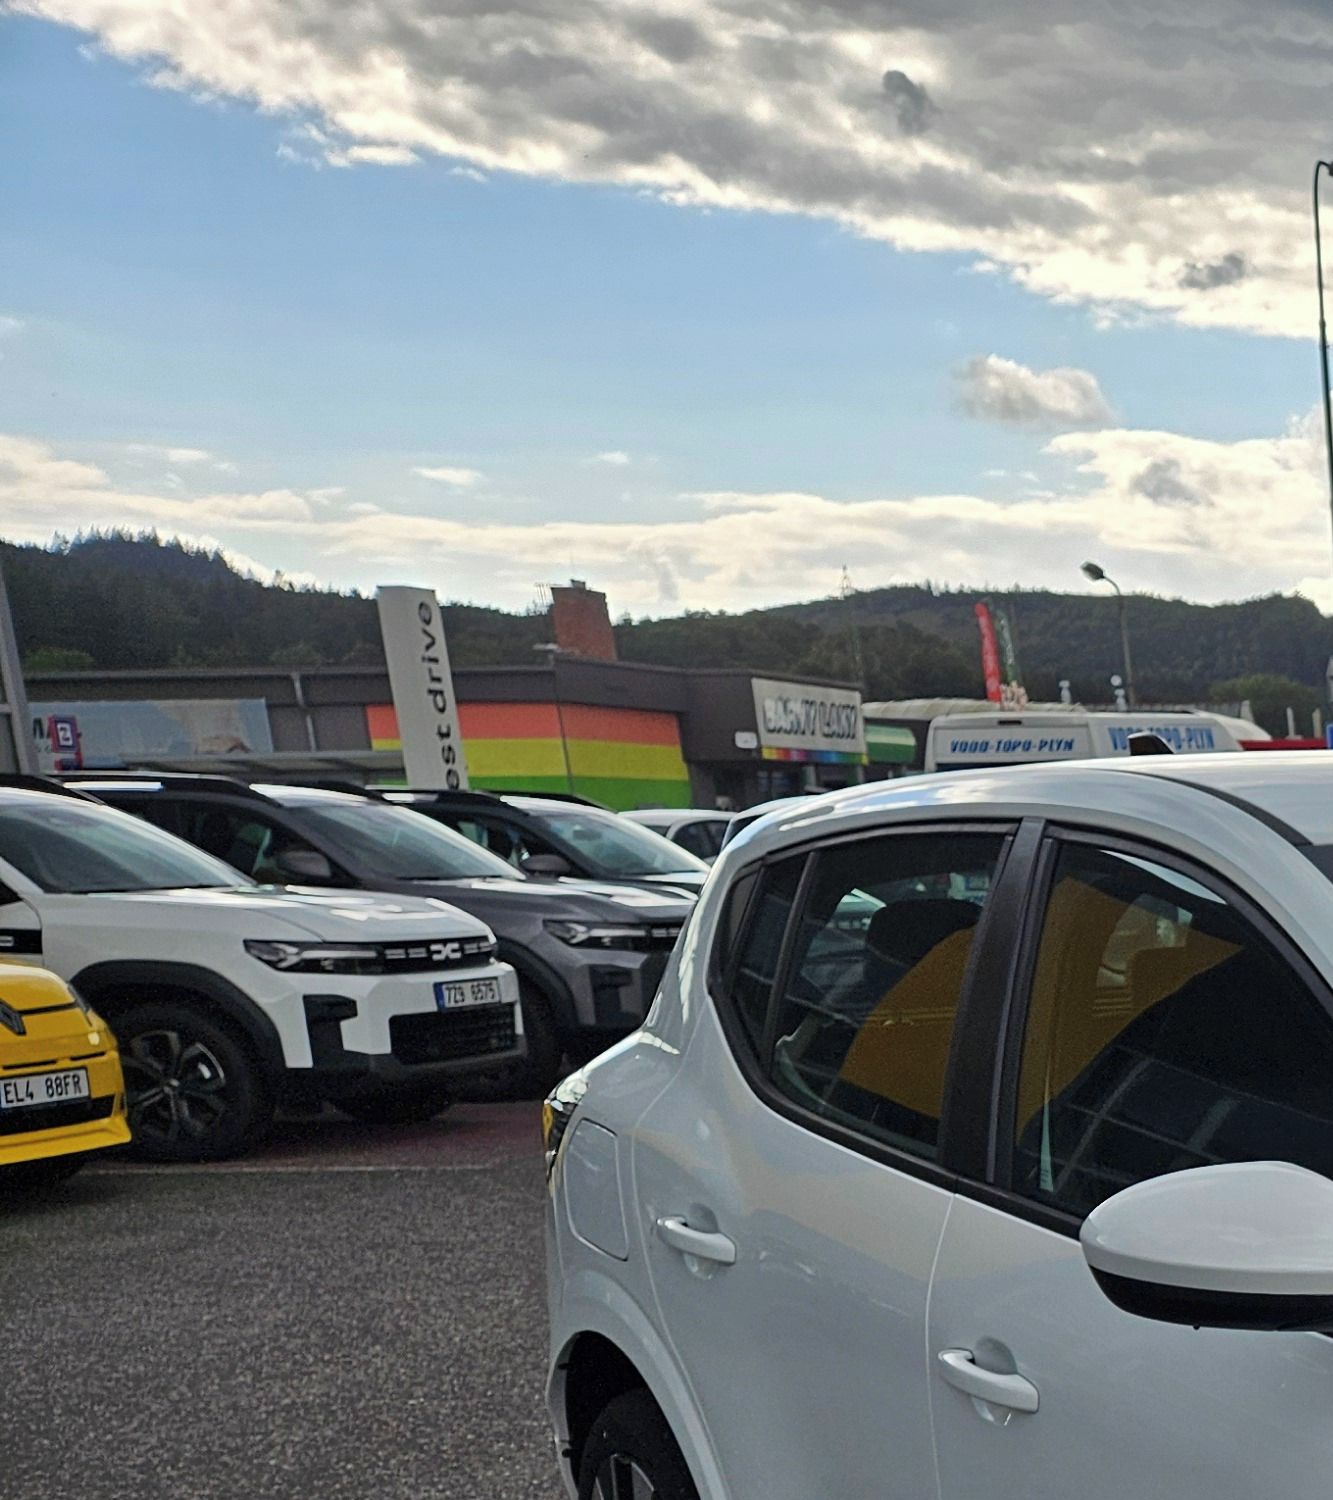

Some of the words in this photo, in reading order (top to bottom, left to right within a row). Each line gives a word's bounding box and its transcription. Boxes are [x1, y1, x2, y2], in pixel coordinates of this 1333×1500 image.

[418, 601, 446, 714] drive
[436, 723, 460, 790] est
[3, 1080, 34, 1104] EL4
[45, 1073, 82, 1098] 88FR
